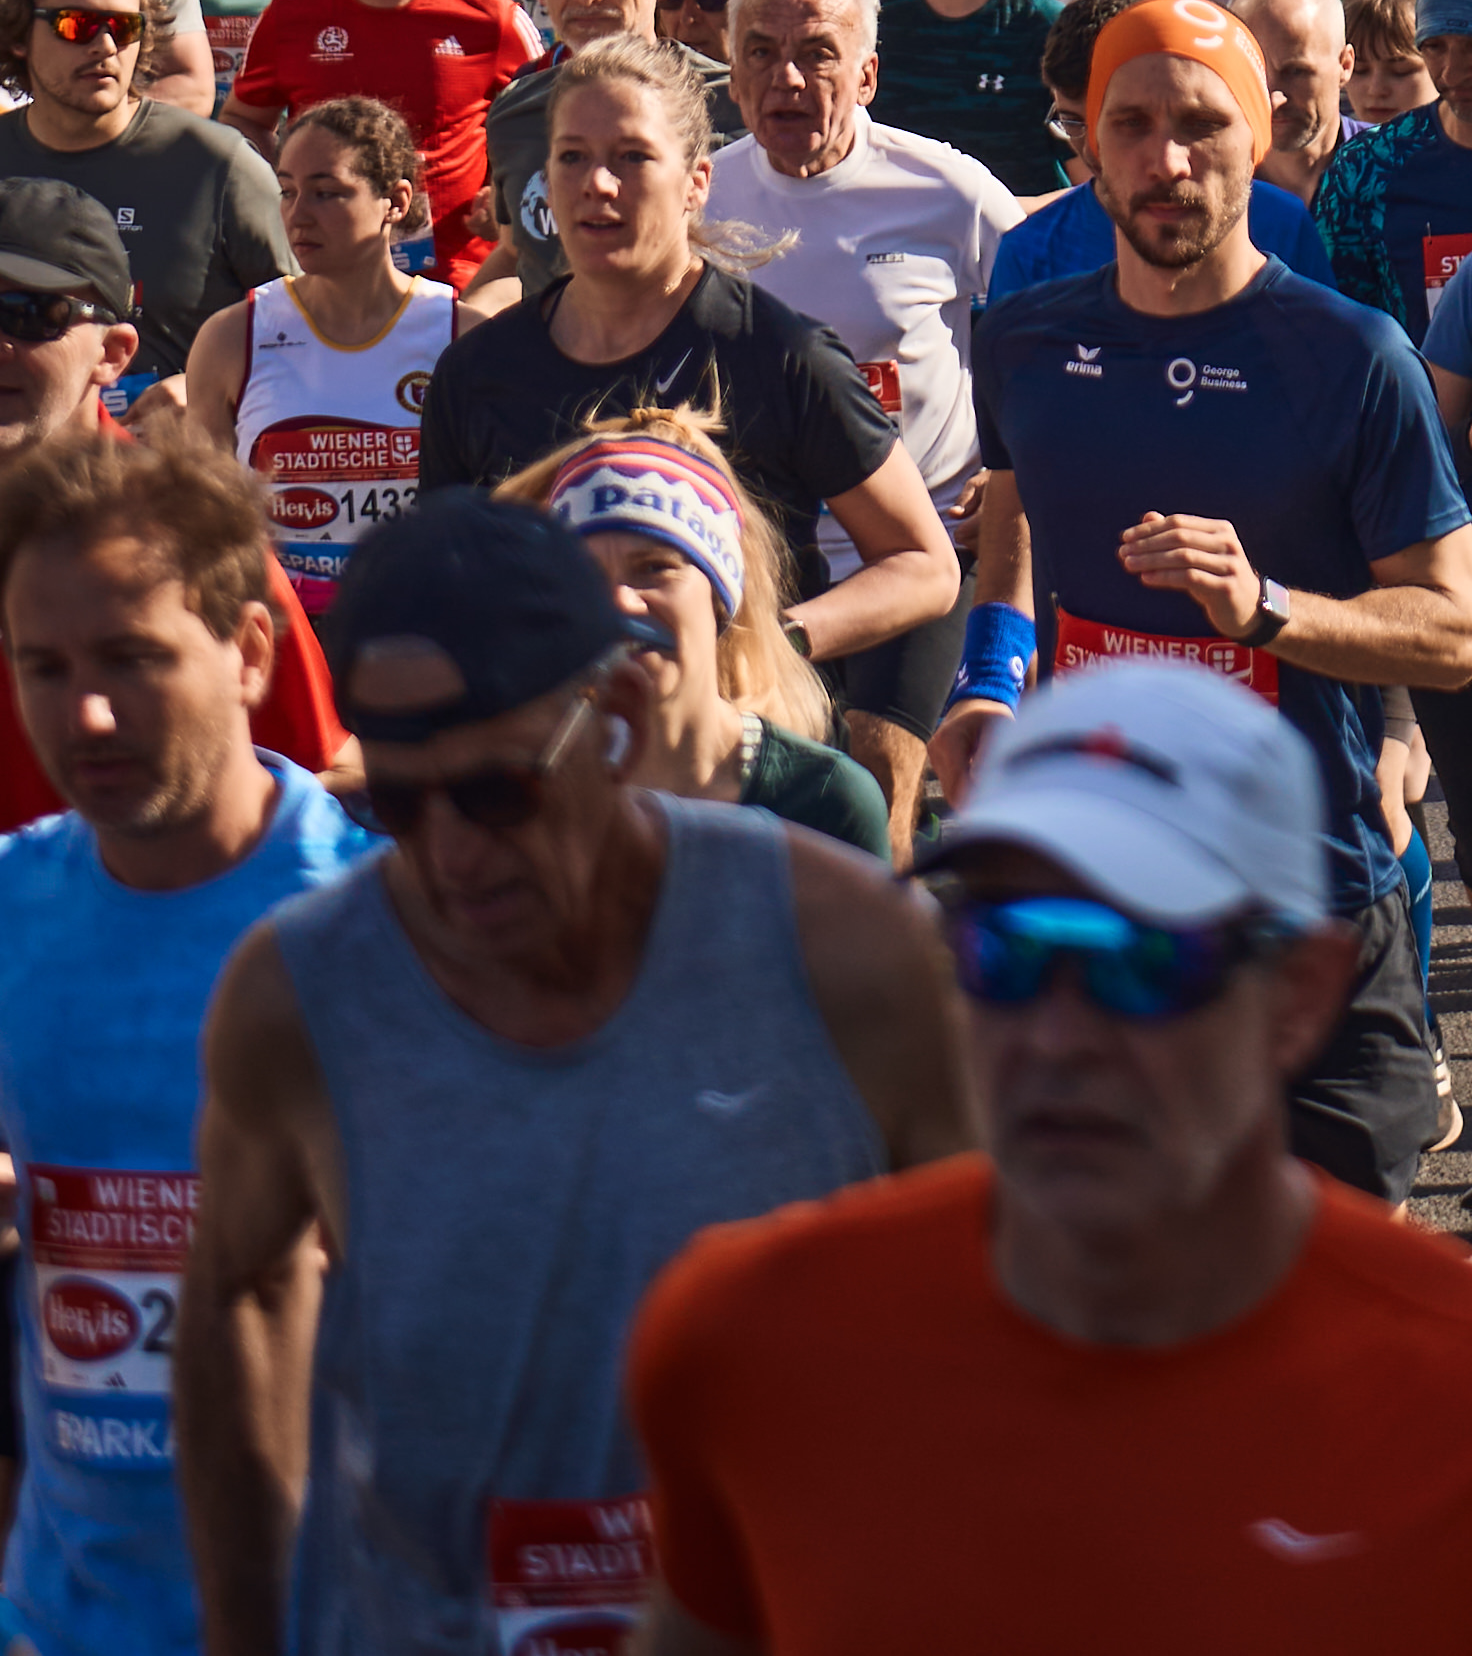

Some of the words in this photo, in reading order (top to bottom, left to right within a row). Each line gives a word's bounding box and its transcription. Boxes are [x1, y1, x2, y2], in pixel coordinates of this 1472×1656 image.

[1200, 375, 1248, 391] Business
[311, 431, 389, 452] WIENER
[273, 446, 390, 471] STÄDTISCHE
[272, 497, 334, 526] Hervis
[588, 481, 744, 583] patago
[1103, 628, 1201, 665] WIENER
